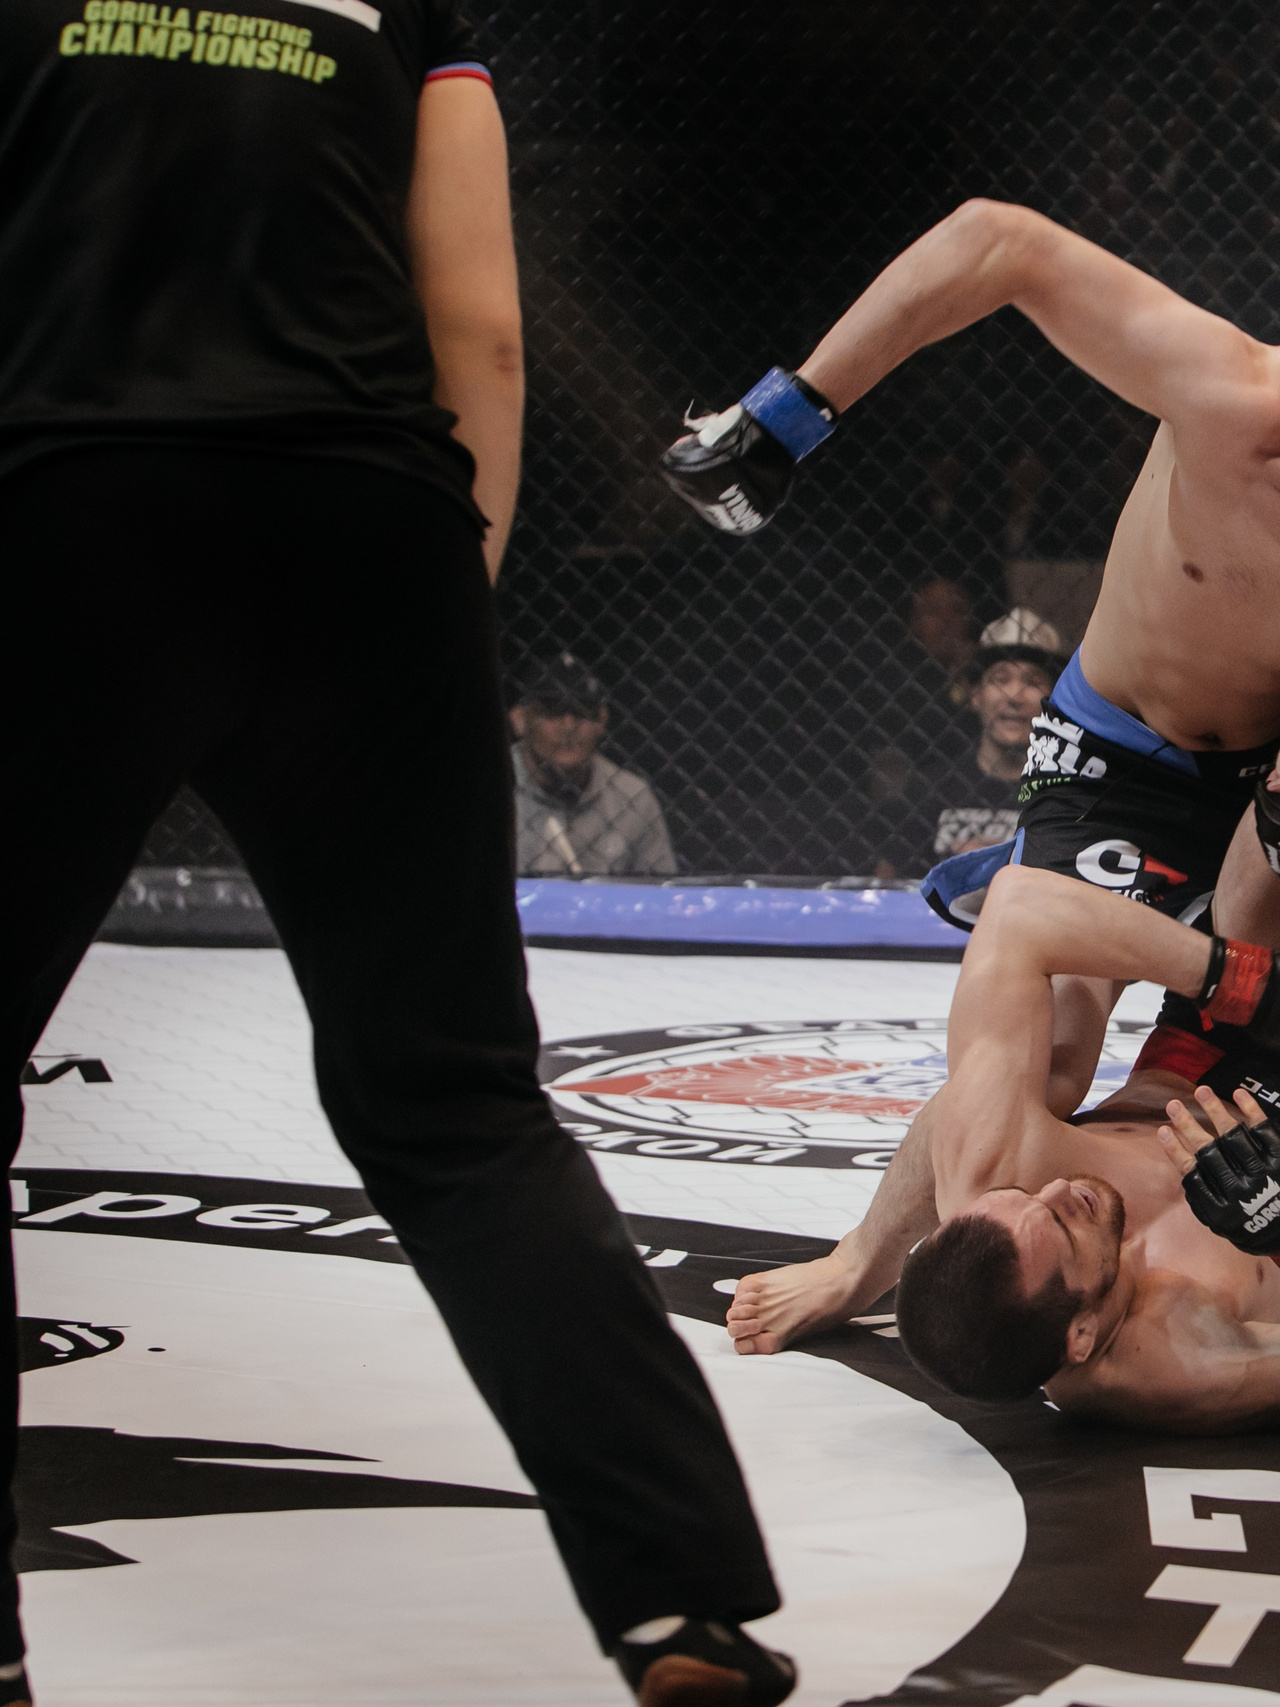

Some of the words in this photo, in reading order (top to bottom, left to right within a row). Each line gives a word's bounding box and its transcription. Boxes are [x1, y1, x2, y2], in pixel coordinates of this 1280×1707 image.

[84, 0, 190, 29] GORILLA
[195, 10, 313, 48] FIGHTING
[59, 22, 338, 83] CHAMPIONSHIP
